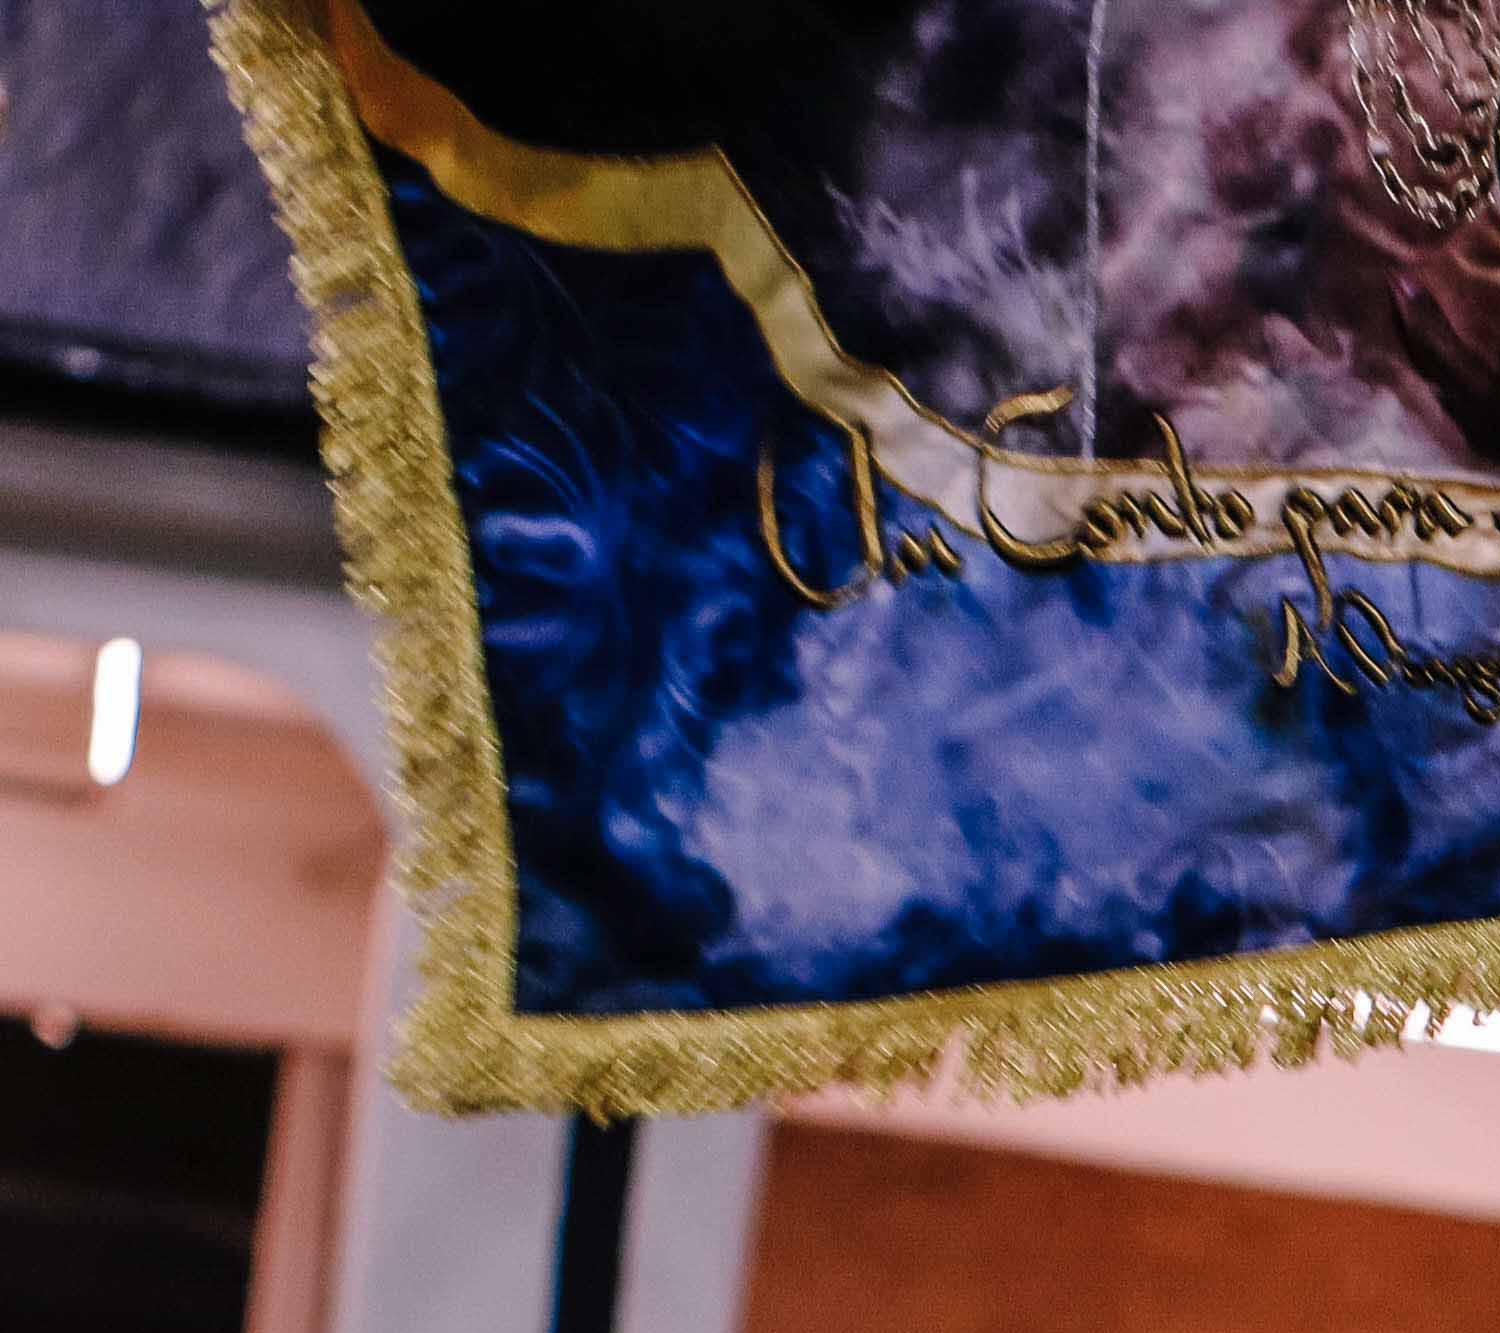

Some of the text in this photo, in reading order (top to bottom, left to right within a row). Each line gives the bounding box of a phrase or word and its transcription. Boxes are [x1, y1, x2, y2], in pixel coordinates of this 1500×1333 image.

[756, 425, 964, 610] Um
[979, 386, 1255, 573] Conto
[1283, 487, 1472, 634] para
